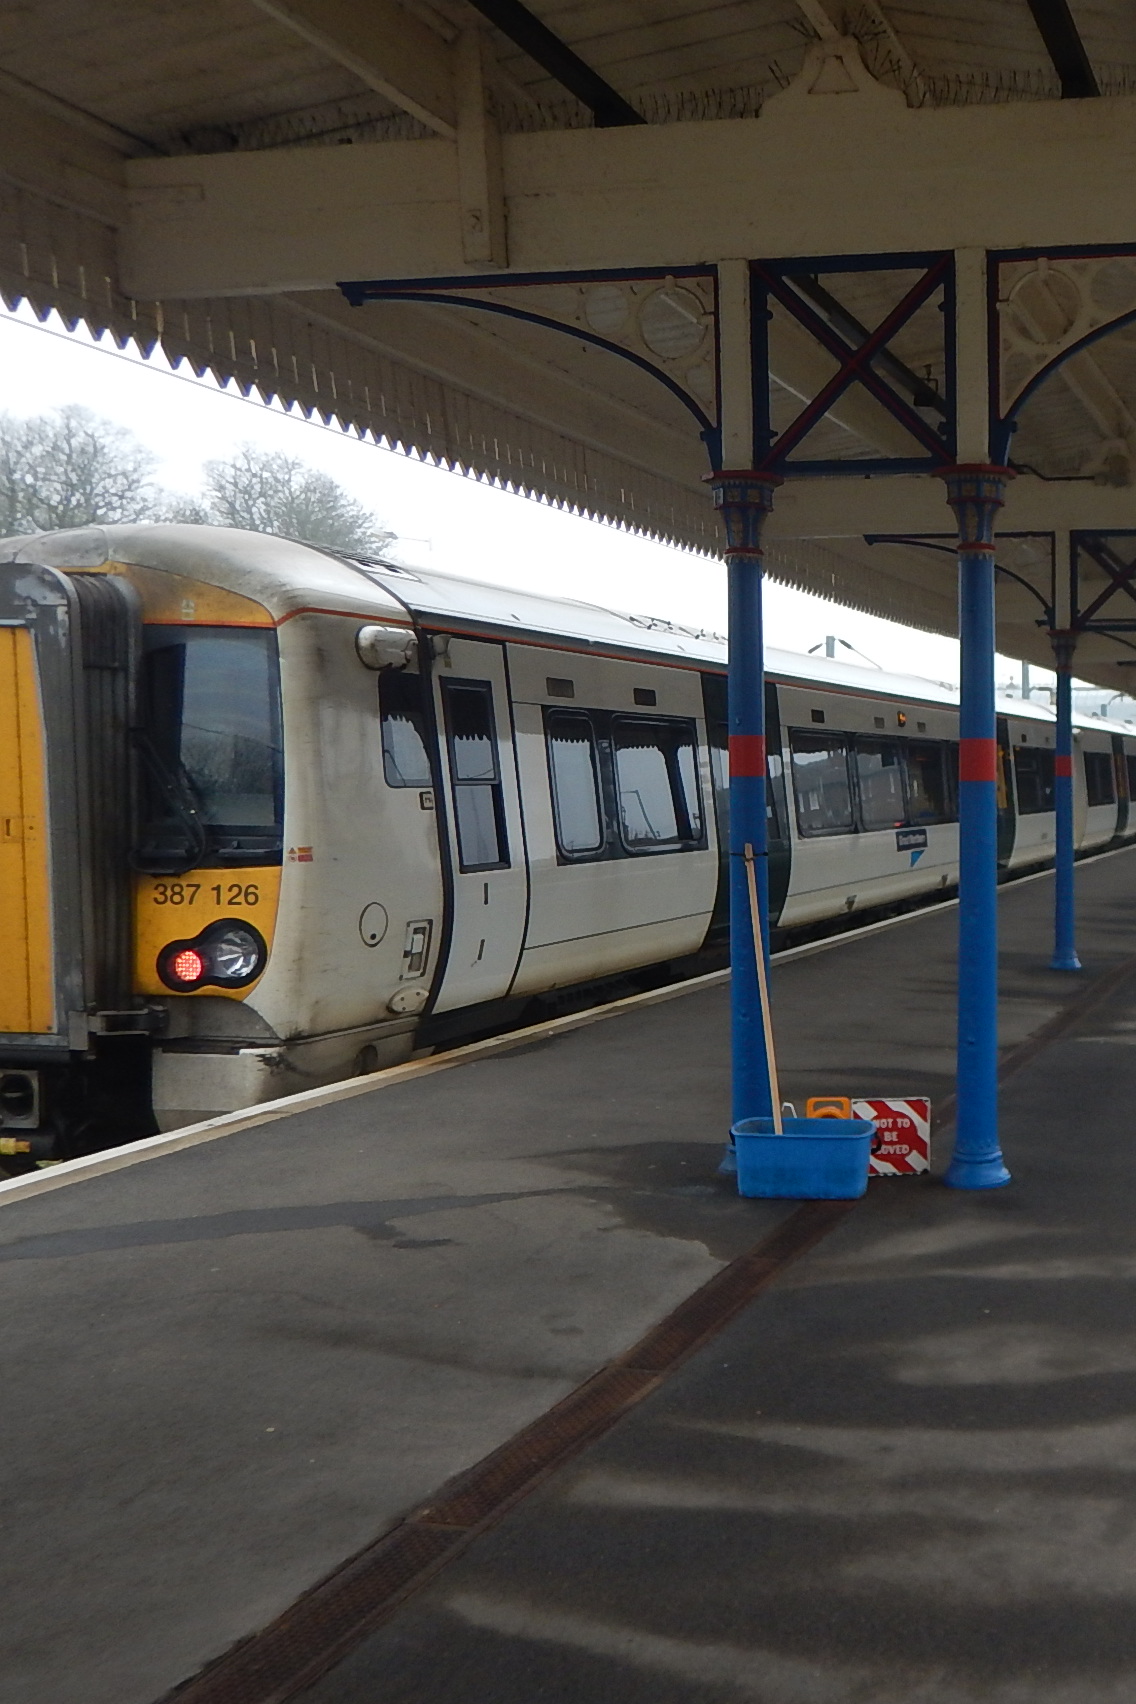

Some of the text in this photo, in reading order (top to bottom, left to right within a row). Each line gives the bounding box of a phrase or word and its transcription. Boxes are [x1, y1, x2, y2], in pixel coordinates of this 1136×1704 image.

[153, 883, 260, 906] 387 126
[896, 1118, 911, 1129] TO
[883, 1131, 899, 1142] BE
